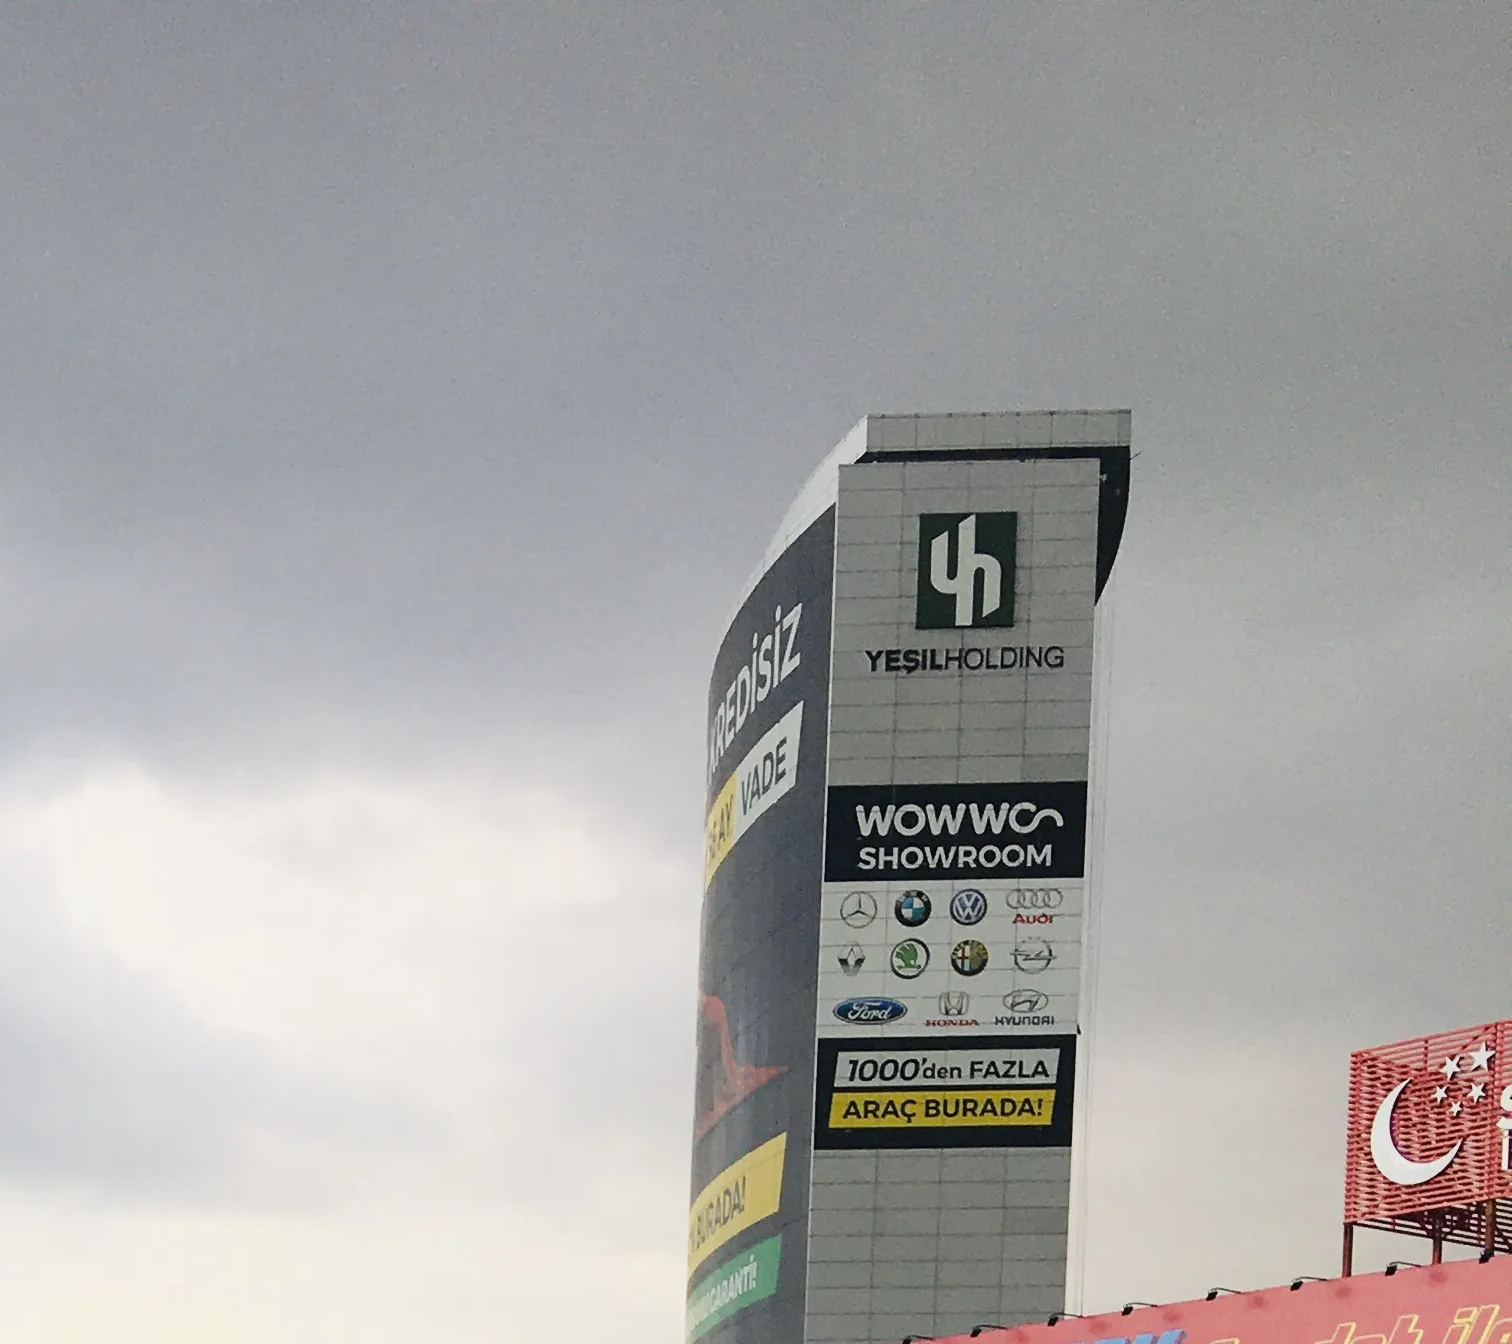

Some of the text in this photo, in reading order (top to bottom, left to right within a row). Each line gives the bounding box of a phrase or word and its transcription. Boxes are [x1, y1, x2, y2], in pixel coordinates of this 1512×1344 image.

[740, 736, 788, 816] VADE
[858, 843, 1052, 870] SHOWROOM
[847, 1001, 892, 1021] Ford
[994, 1015, 1055, 1026] HYUNDAI
[925, 1018, 980, 1028] HONDA
[969, 1058, 1050, 1081] FAZLA
[842, 1096, 1043, 1123] ARAÇ BURADA!
